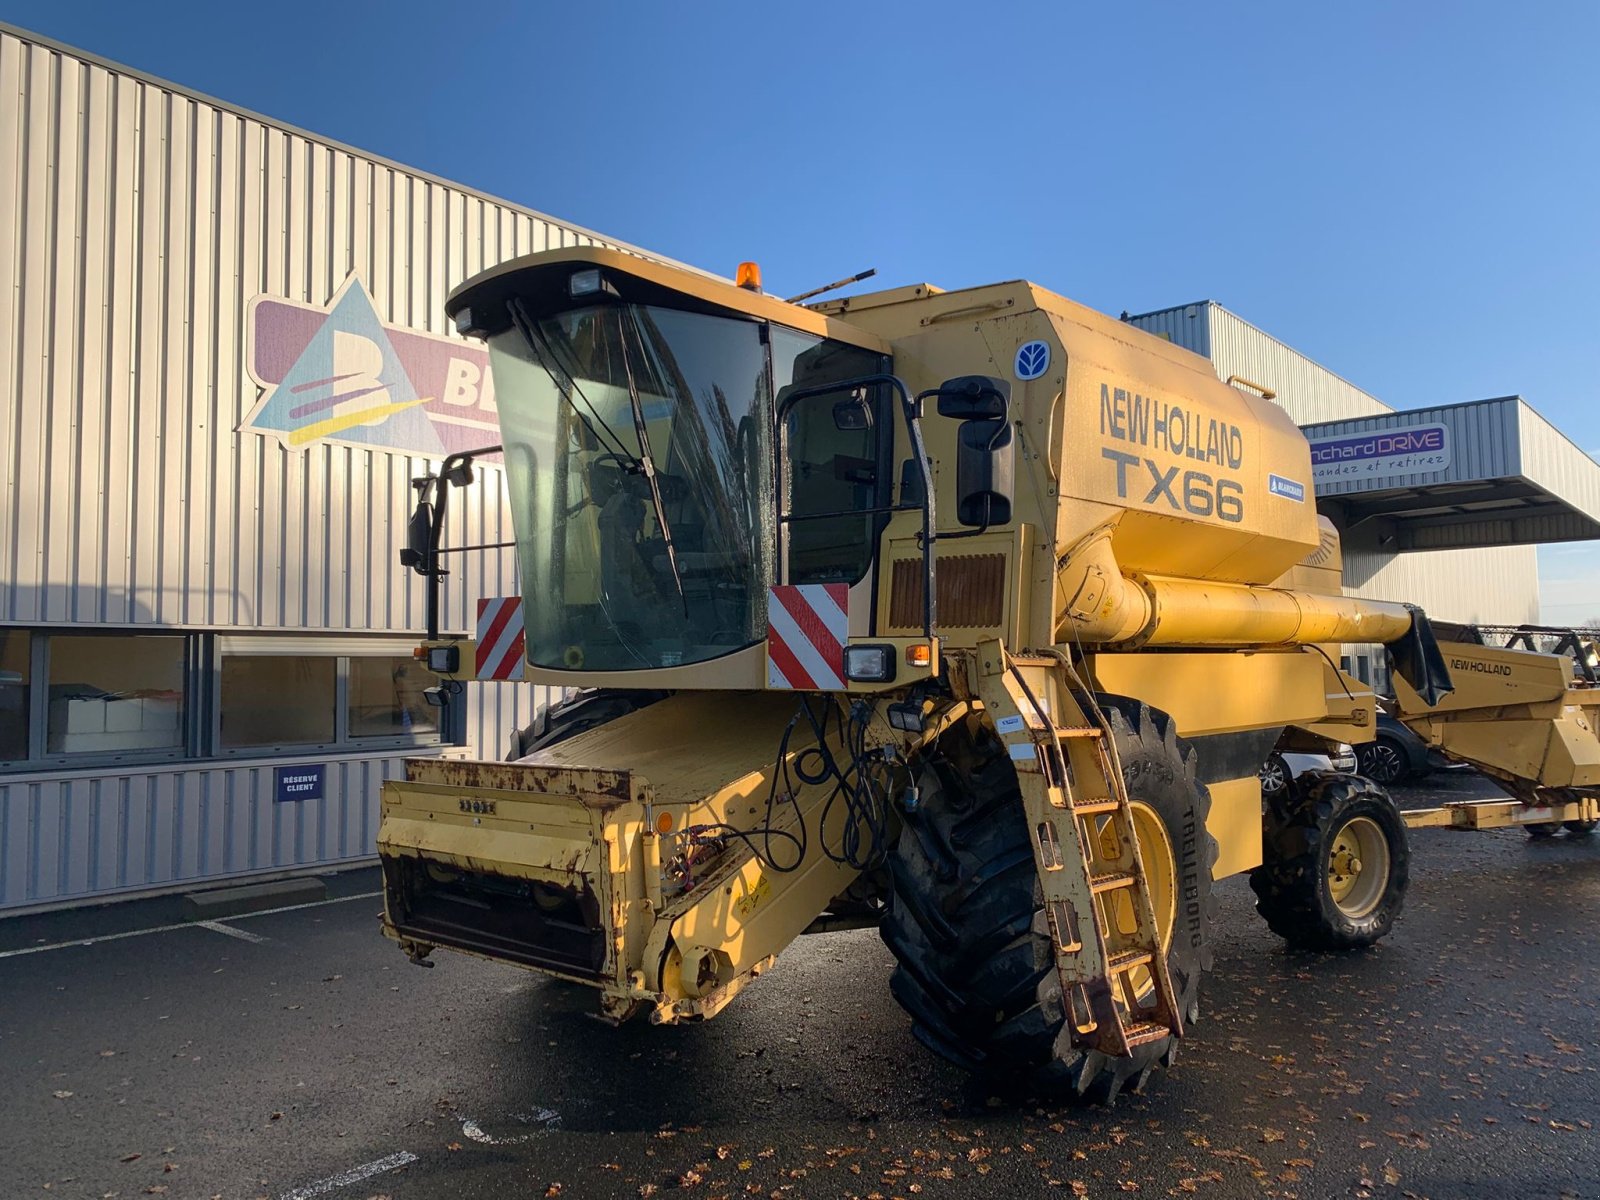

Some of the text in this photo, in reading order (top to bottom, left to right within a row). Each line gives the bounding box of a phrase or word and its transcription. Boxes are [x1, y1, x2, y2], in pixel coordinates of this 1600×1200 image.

[1100, 383, 1243, 470] NEW HOLLAND
[1101, 447, 1244, 523] TX66
[1366, 459, 1381, 471] et
[1389, 454, 1444, 468] retirez
[1450, 659, 1512, 676] NEW HOLLAND
[287, 783, 314, 792] CLIENT
[1182, 806, 1202, 948] TRELLEBORG
